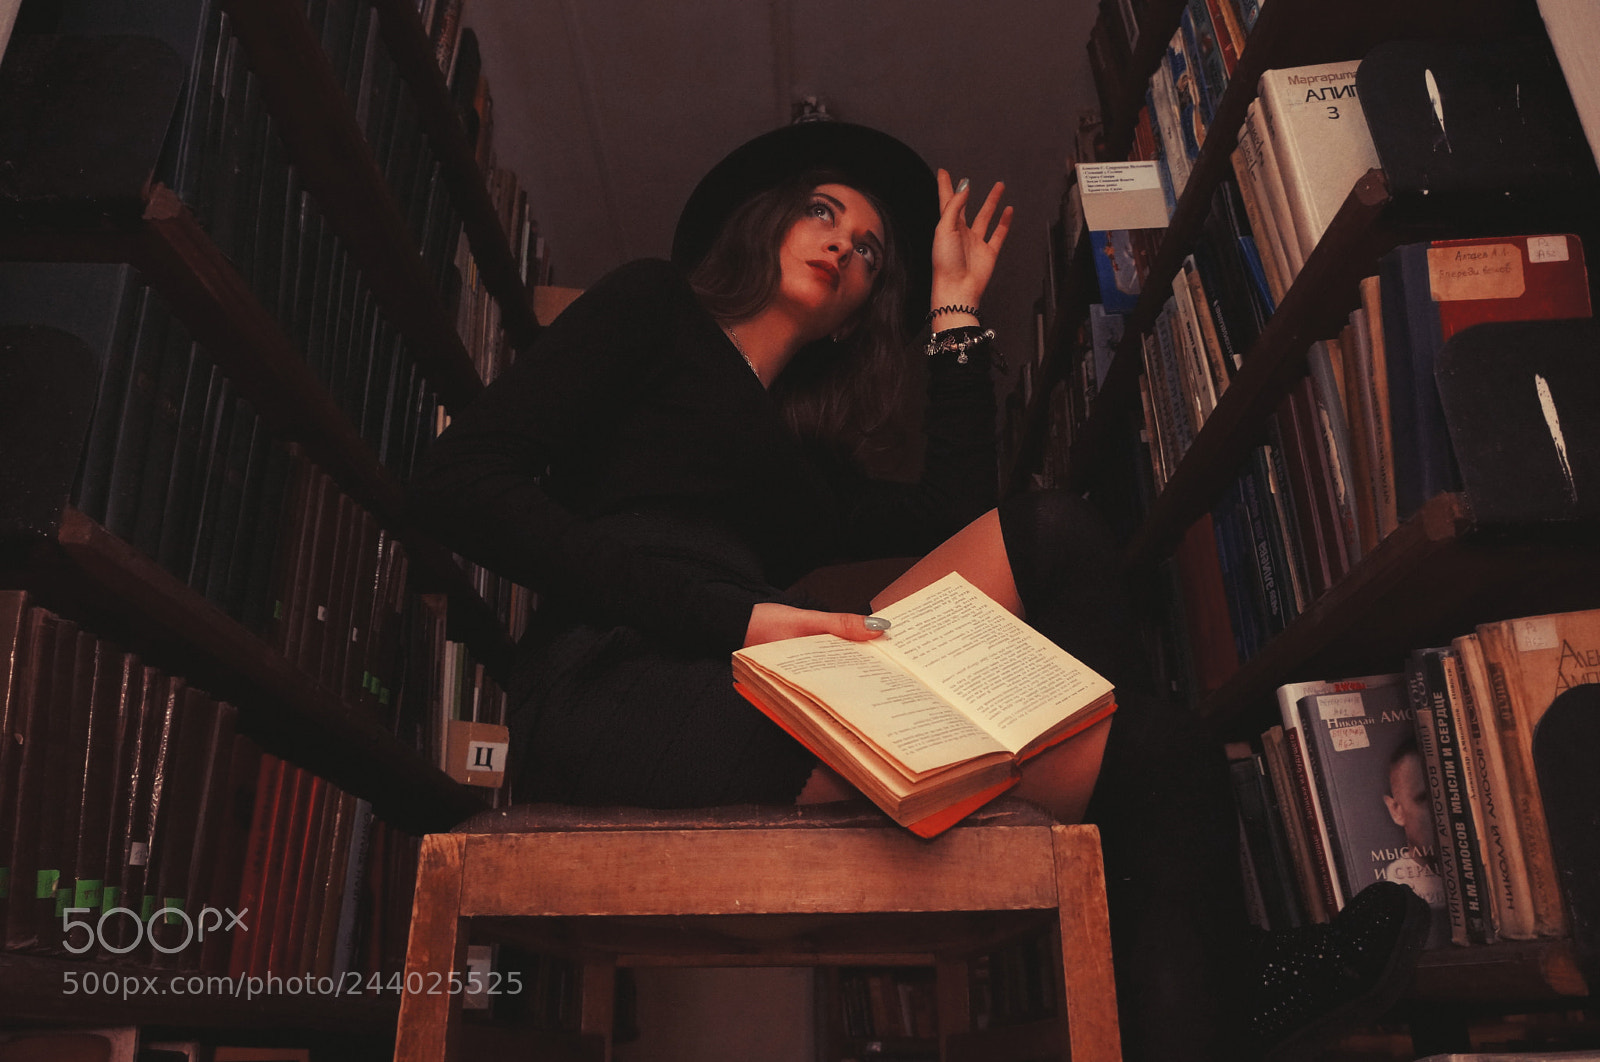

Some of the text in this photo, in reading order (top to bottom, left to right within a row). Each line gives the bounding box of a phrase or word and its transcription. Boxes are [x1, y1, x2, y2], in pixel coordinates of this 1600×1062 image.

[1305, 84, 1358, 103] АЛИГ
[1326, 106, 1341, 120] 3
[1327, 708, 1416, 729] Николай АМО
[1433, 691, 1450, 745] СЕРДЦЕ
[472, 746, 494, 771] Ц
[1442, 748, 1453, 759] И
[1445, 760, 1463, 814] МЫСЛИ
[1428, 765, 1449, 837] АМОСОВ
[1478, 748, 1515, 910] НИКОЛАЙ АМОСОВ
[1371, 845, 1434, 862] МЫСЛИ
[1374, 868, 1388, 880] И
[1455, 822, 1480, 913] Н.М.АМОСОВ
[1443, 845, 1463, 927] НИКОЛАЙ
